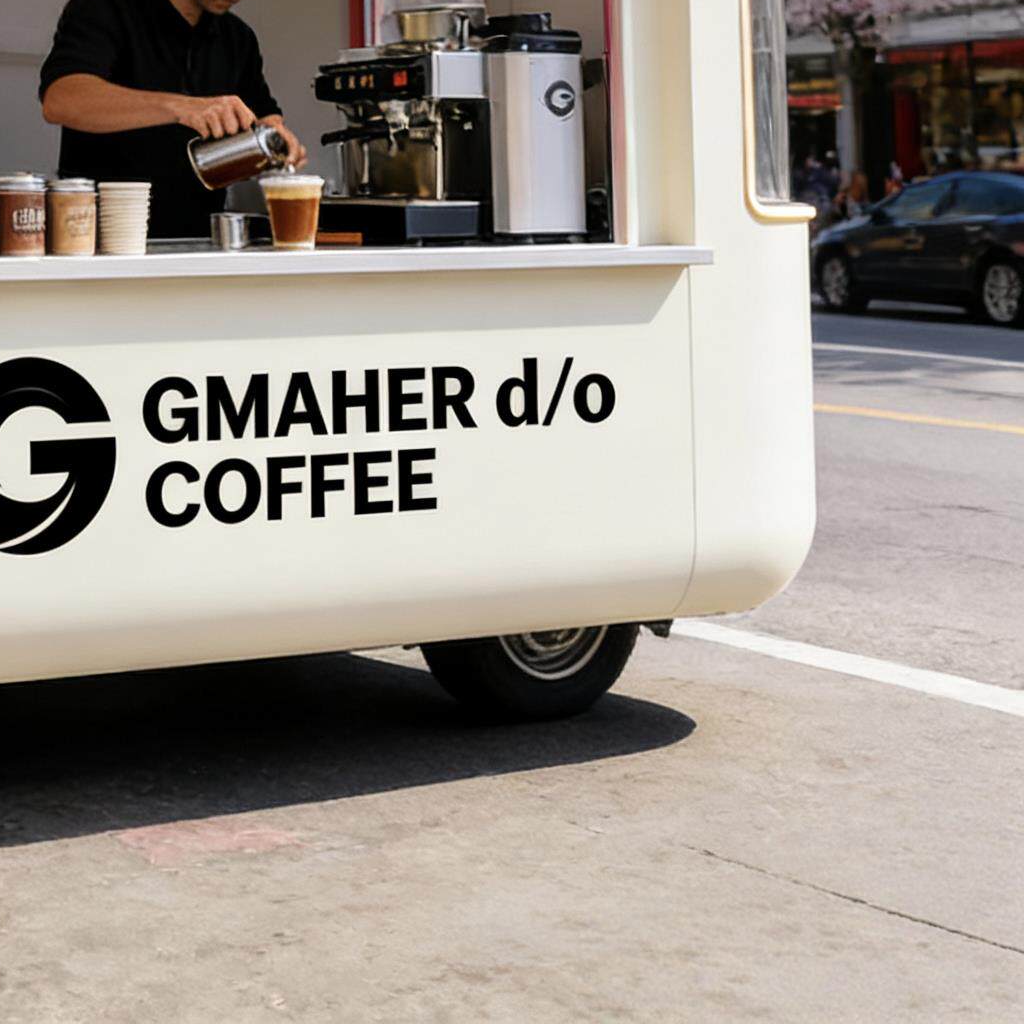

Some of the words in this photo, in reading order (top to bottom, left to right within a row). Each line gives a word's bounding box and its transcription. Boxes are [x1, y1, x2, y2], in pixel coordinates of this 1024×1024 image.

[142, 366, 478, 444] GMAHER
[495, 356, 616, 428] d/o
[145, 447, 438, 528] COFFEE
